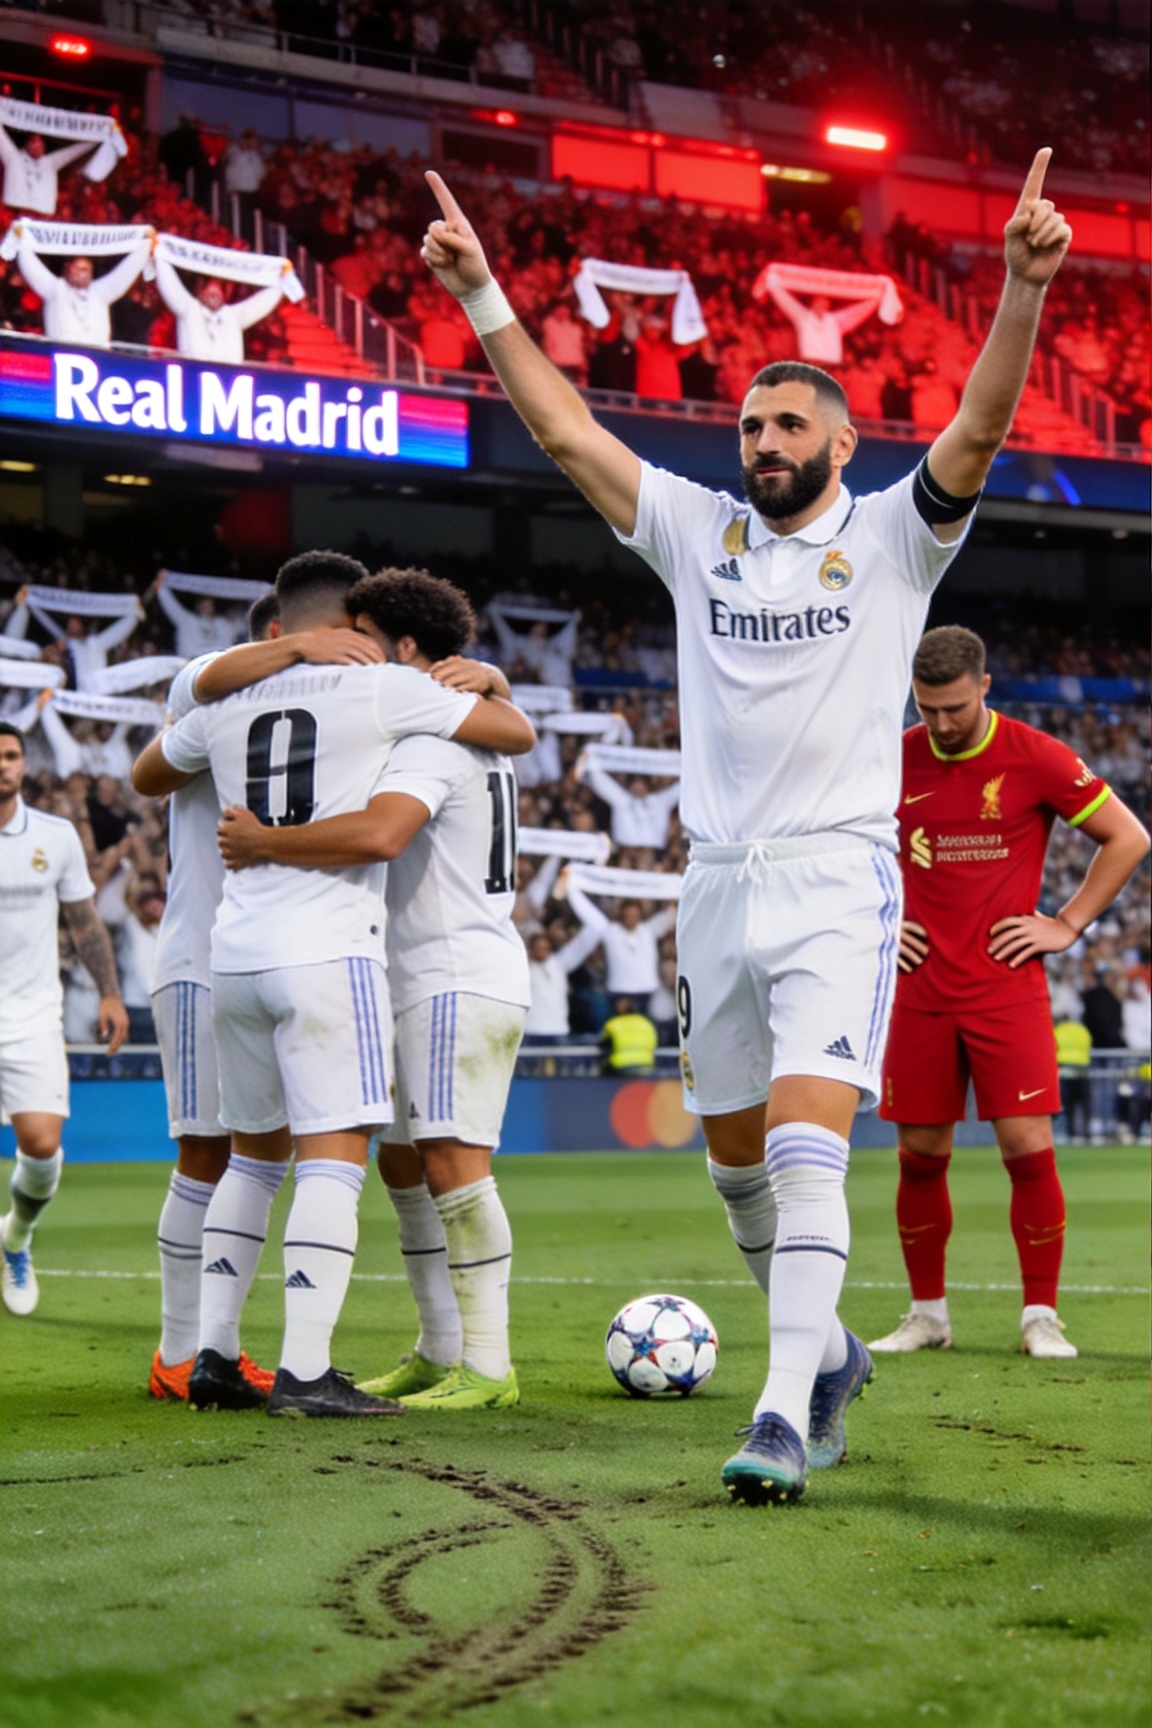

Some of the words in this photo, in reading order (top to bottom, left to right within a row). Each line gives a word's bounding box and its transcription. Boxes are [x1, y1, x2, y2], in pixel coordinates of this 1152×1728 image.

[53, 352, 188, 432] Real
[199, 370, 400, 456] Madrid
[708, 597, 851, 642] Emirates
[678, 975, 692, 1039] 9
